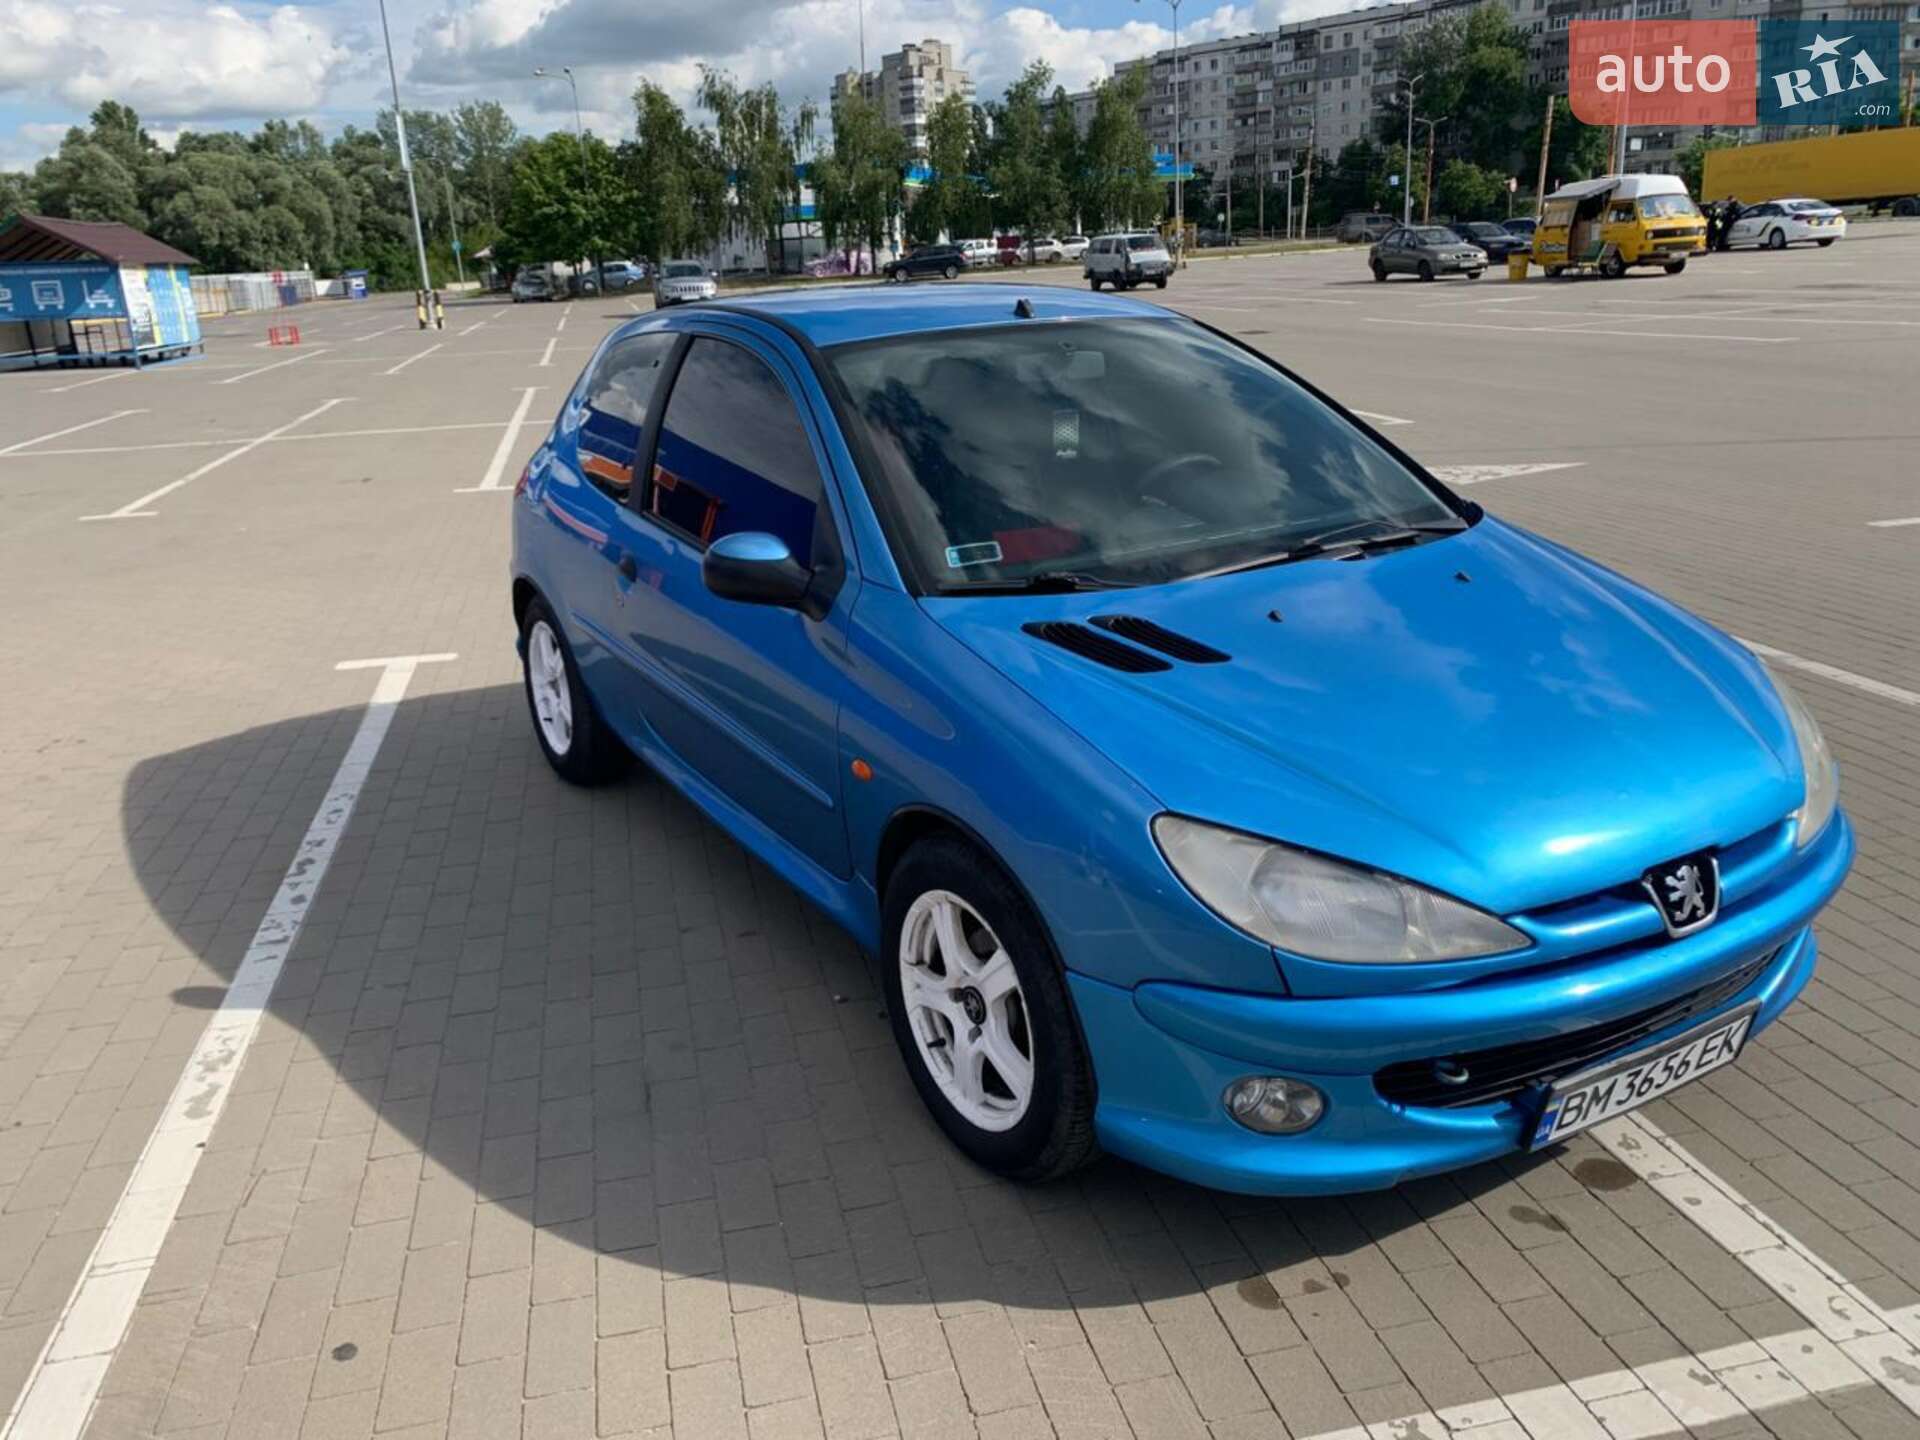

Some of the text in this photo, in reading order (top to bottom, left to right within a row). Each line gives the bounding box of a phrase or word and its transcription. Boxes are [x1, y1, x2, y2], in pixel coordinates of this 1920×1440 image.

[1553, 1019, 1745, 1131] BM 3656 EK
